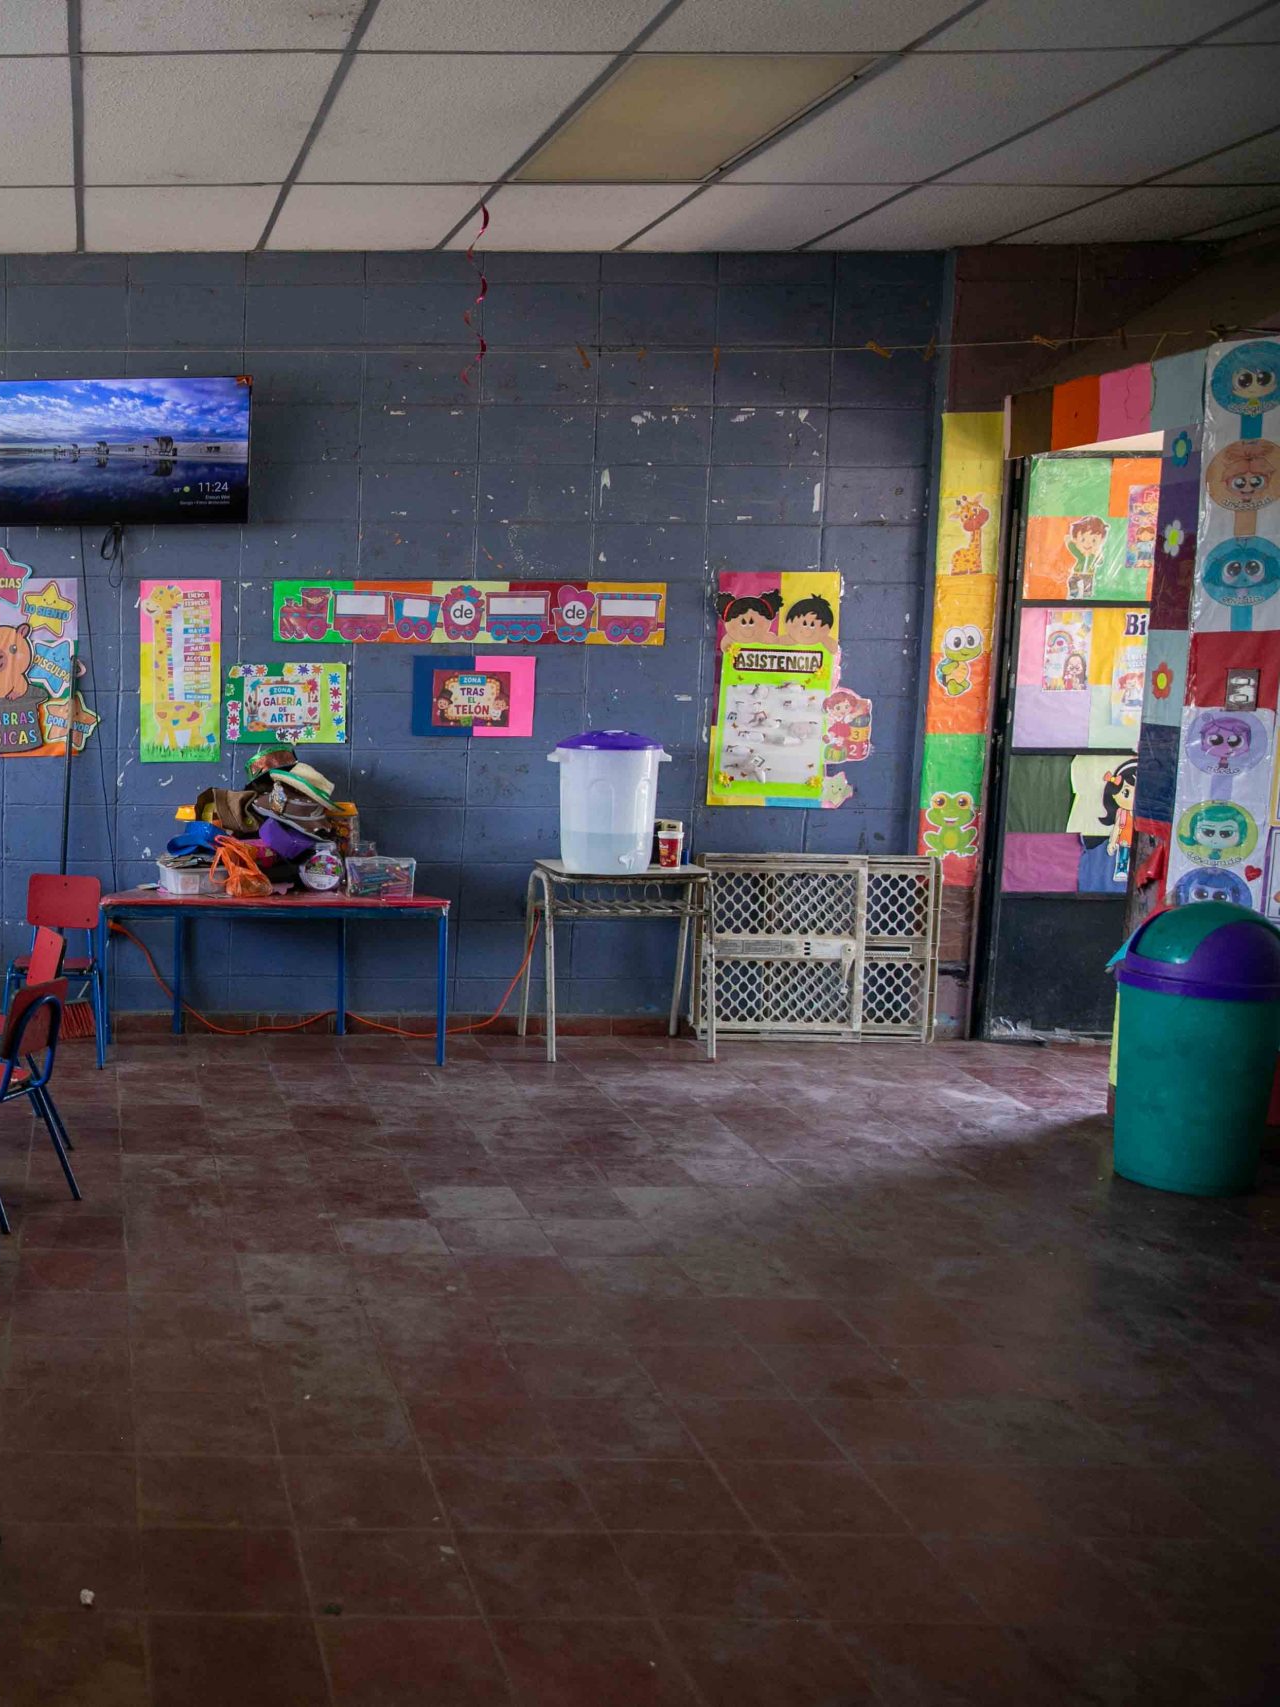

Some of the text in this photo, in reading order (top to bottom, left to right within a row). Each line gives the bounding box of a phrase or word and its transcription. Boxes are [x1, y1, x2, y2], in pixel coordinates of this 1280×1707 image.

[198, 481, 229, 493] 11:24
[25, 604, 69, 620] LO SIENTO
[453, 605, 473, 619] de
[565, 605, 585, 619] de
[735, 652, 819, 670] ASISTENCIA
[33, 654, 70, 682] DISCULPA
[460, 687, 485, 697] TRAS
[468, 696, 477, 704] EL
[454, 702, 489, 715] TELÓN
[47, 714, 65, 728] POR
[270, 713, 296, 722] ARTE
[849, 744, 857, 756] 2
